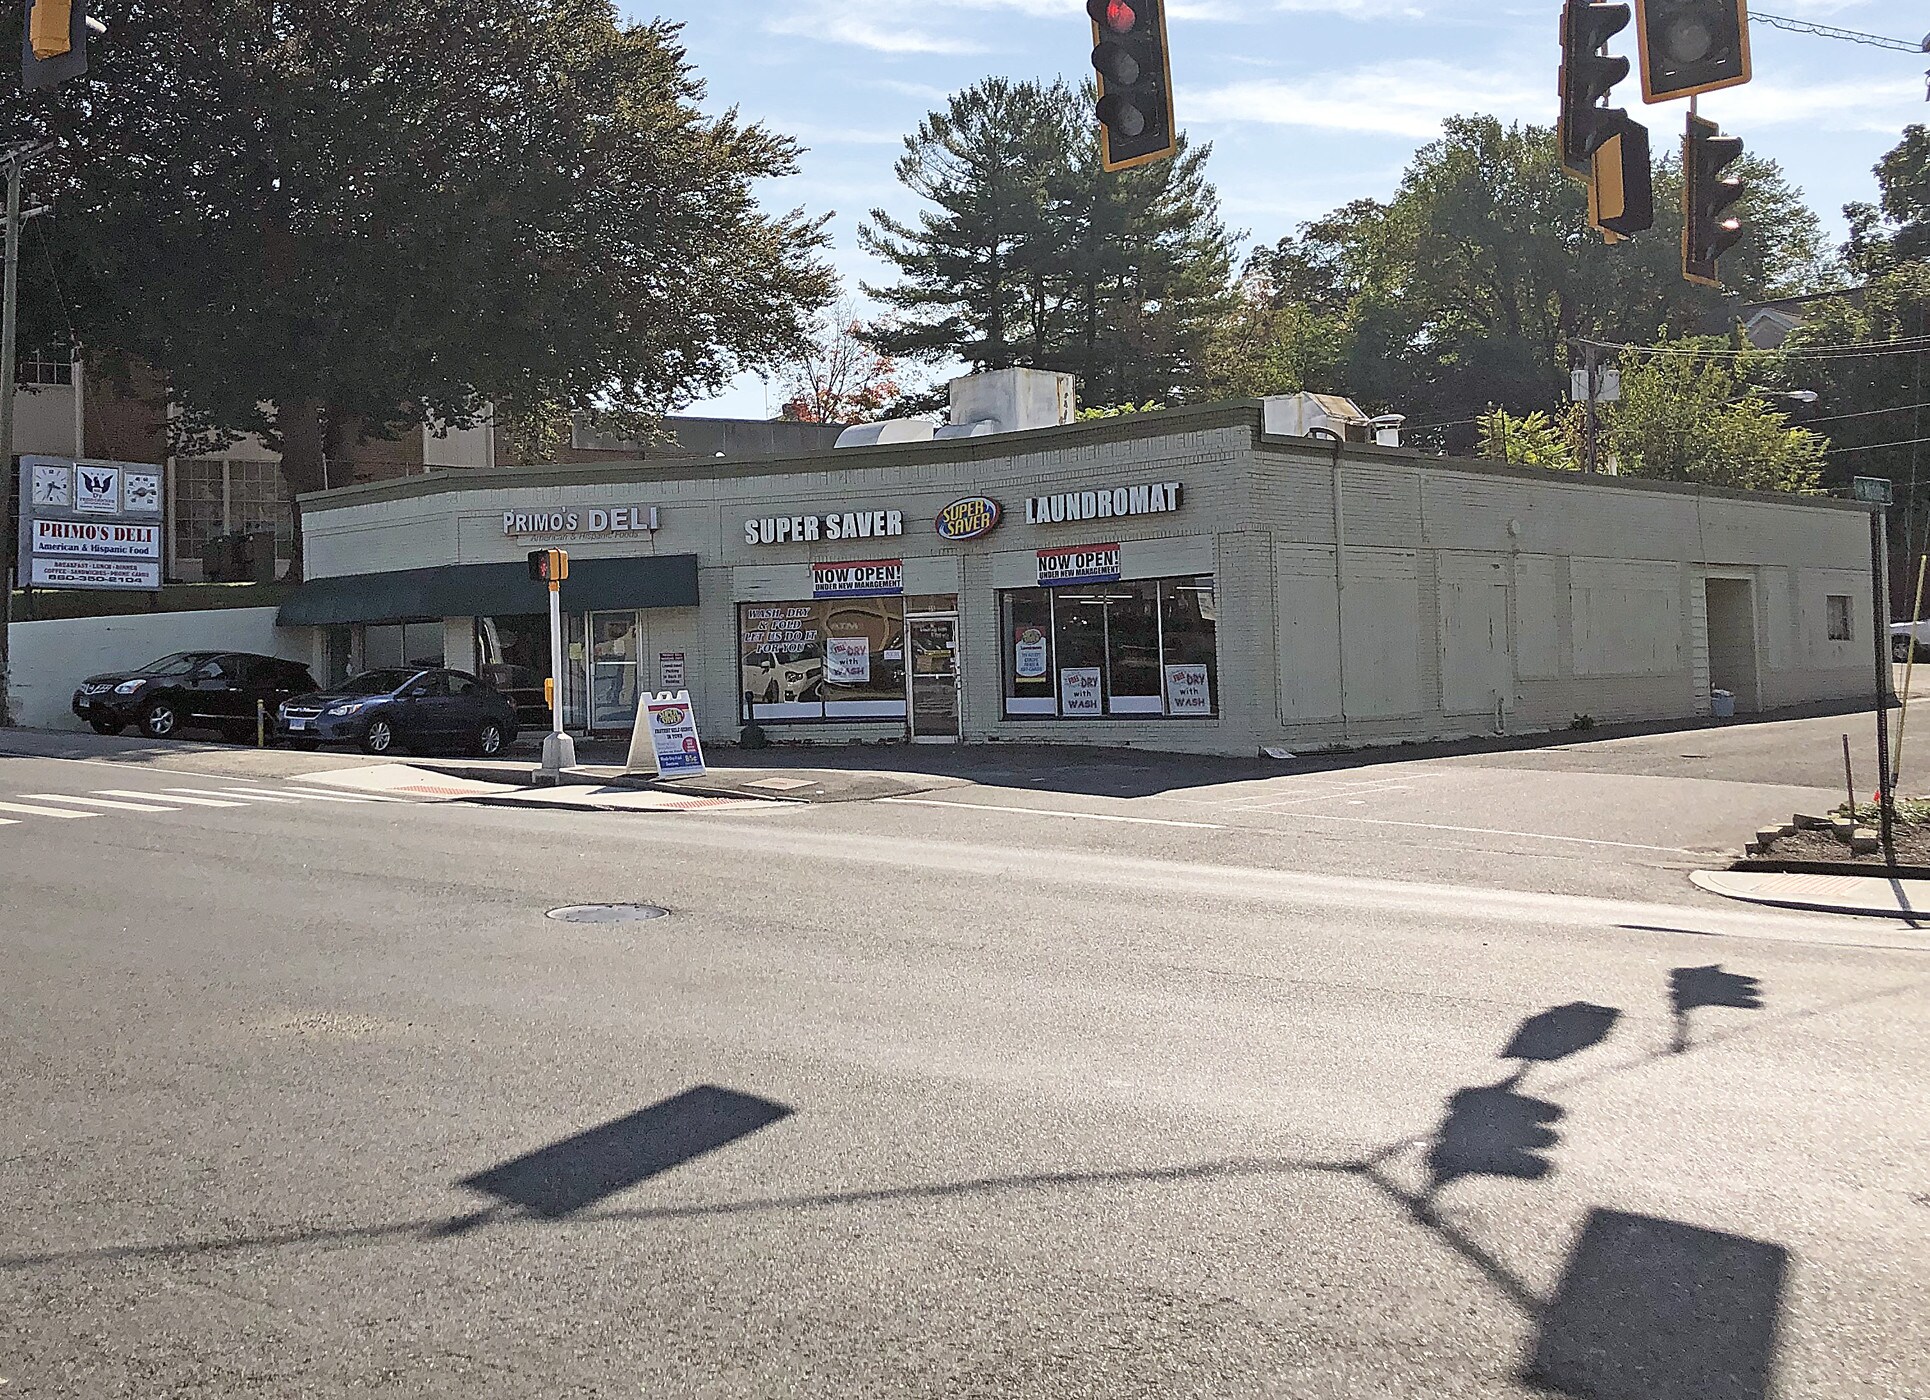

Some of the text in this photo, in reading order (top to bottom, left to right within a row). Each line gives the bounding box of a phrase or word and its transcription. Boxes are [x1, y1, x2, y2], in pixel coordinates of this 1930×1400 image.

[1025, 482, 1181, 525] LAUNDROMAT
[942, 500, 985, 524] SUPER
[503, 506, 659, 534] PRIMO'S DELI
[947, 513, 990, 536] SAVER
[39, 522, 152, 543] PRIMO'S DELI
[744, 510, 903, 545] SUPER SAVER
[38, 542, 150, 555] American & Hispanic Food
[1039, 550, 1119, 572] NOW OPEN!
[814, 566, 901, 584] NOW OPEN!
[1039, 566, 1119, 580] UNDER NEW MANAGEMENT
[815, 580, 901, 590] UNDER NEW MANAGEMENT
[786, 607, 811, 618] DRY
[758, 620, 802, 630] & FOLD
[744, 630, 817, 642] LET US DO IT
[756, 642, 806, 653] FOR YOU
[847, 645, 866, 656] DRY
[1081, 677, 1098, 688] DRY
[1187, 673, 1205, 685] DRY
[1068, 700, 1097, 708] WASH
[1175, 698, 1205, 706] WASH
